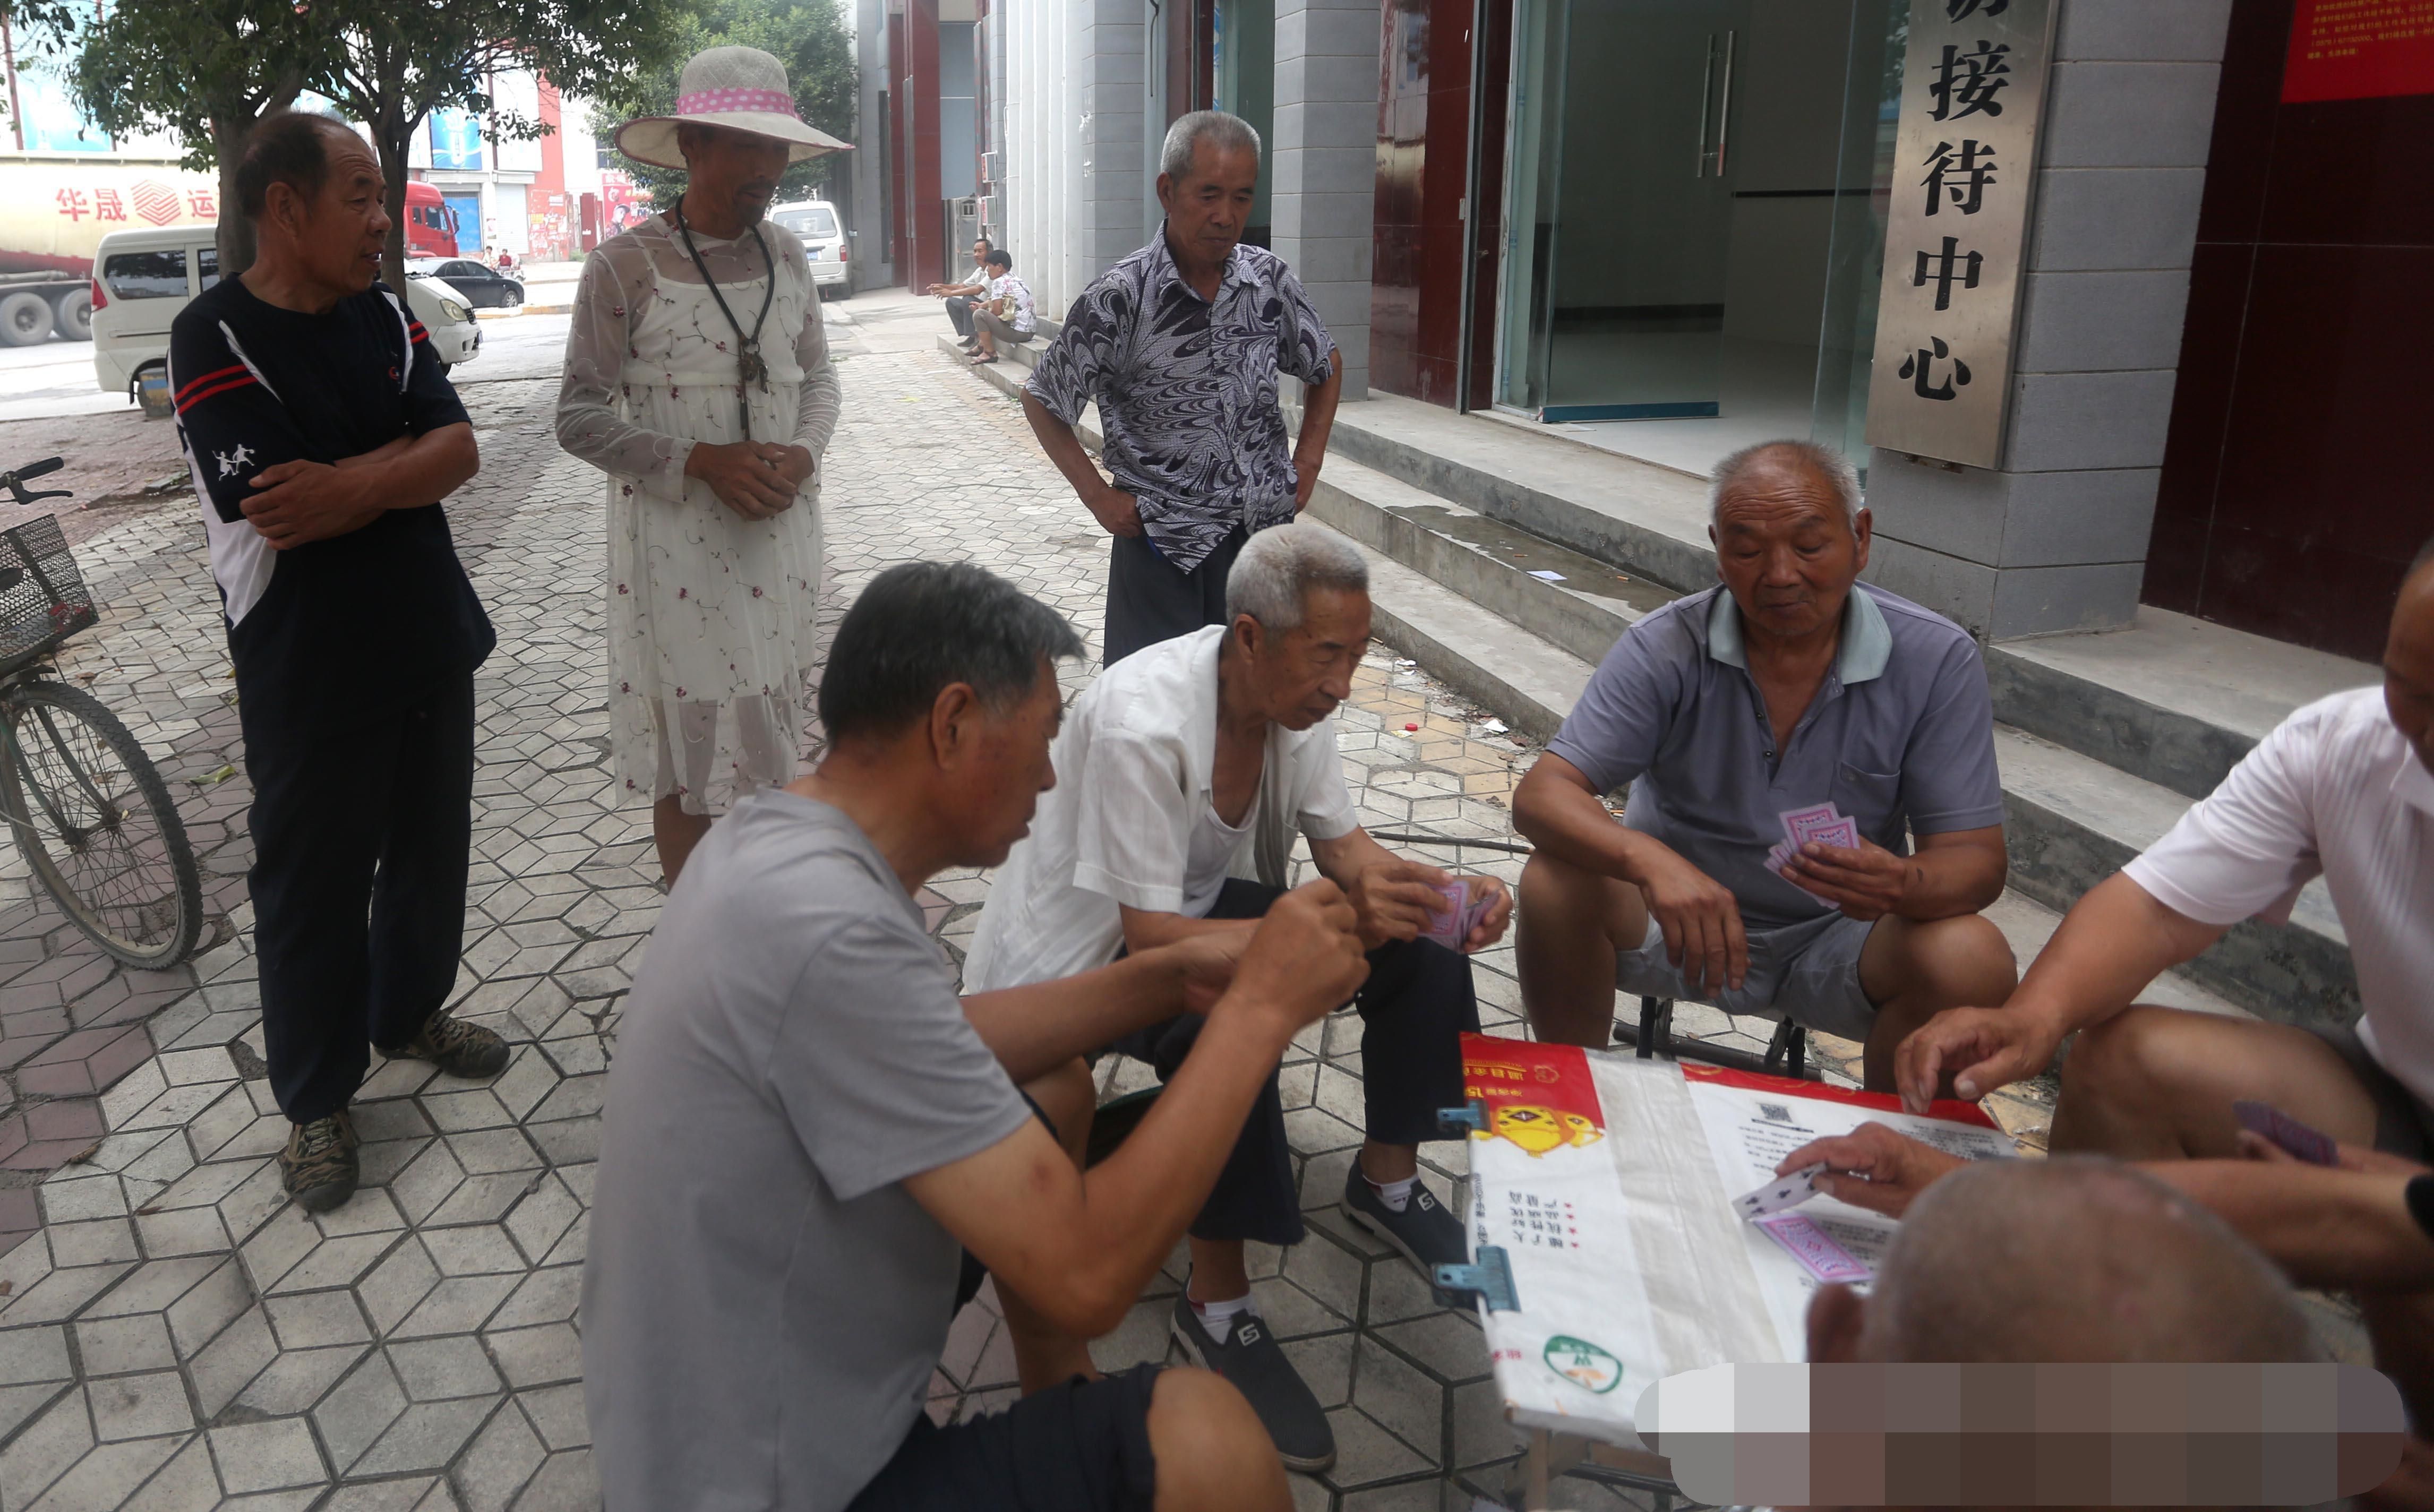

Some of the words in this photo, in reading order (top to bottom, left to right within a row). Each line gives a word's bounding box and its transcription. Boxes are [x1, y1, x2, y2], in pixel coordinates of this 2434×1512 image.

[55, 188, 127, 222] 华晟
[187, 190, 218, 219] 运
[1463, 1085, 1485, 1098] 15
